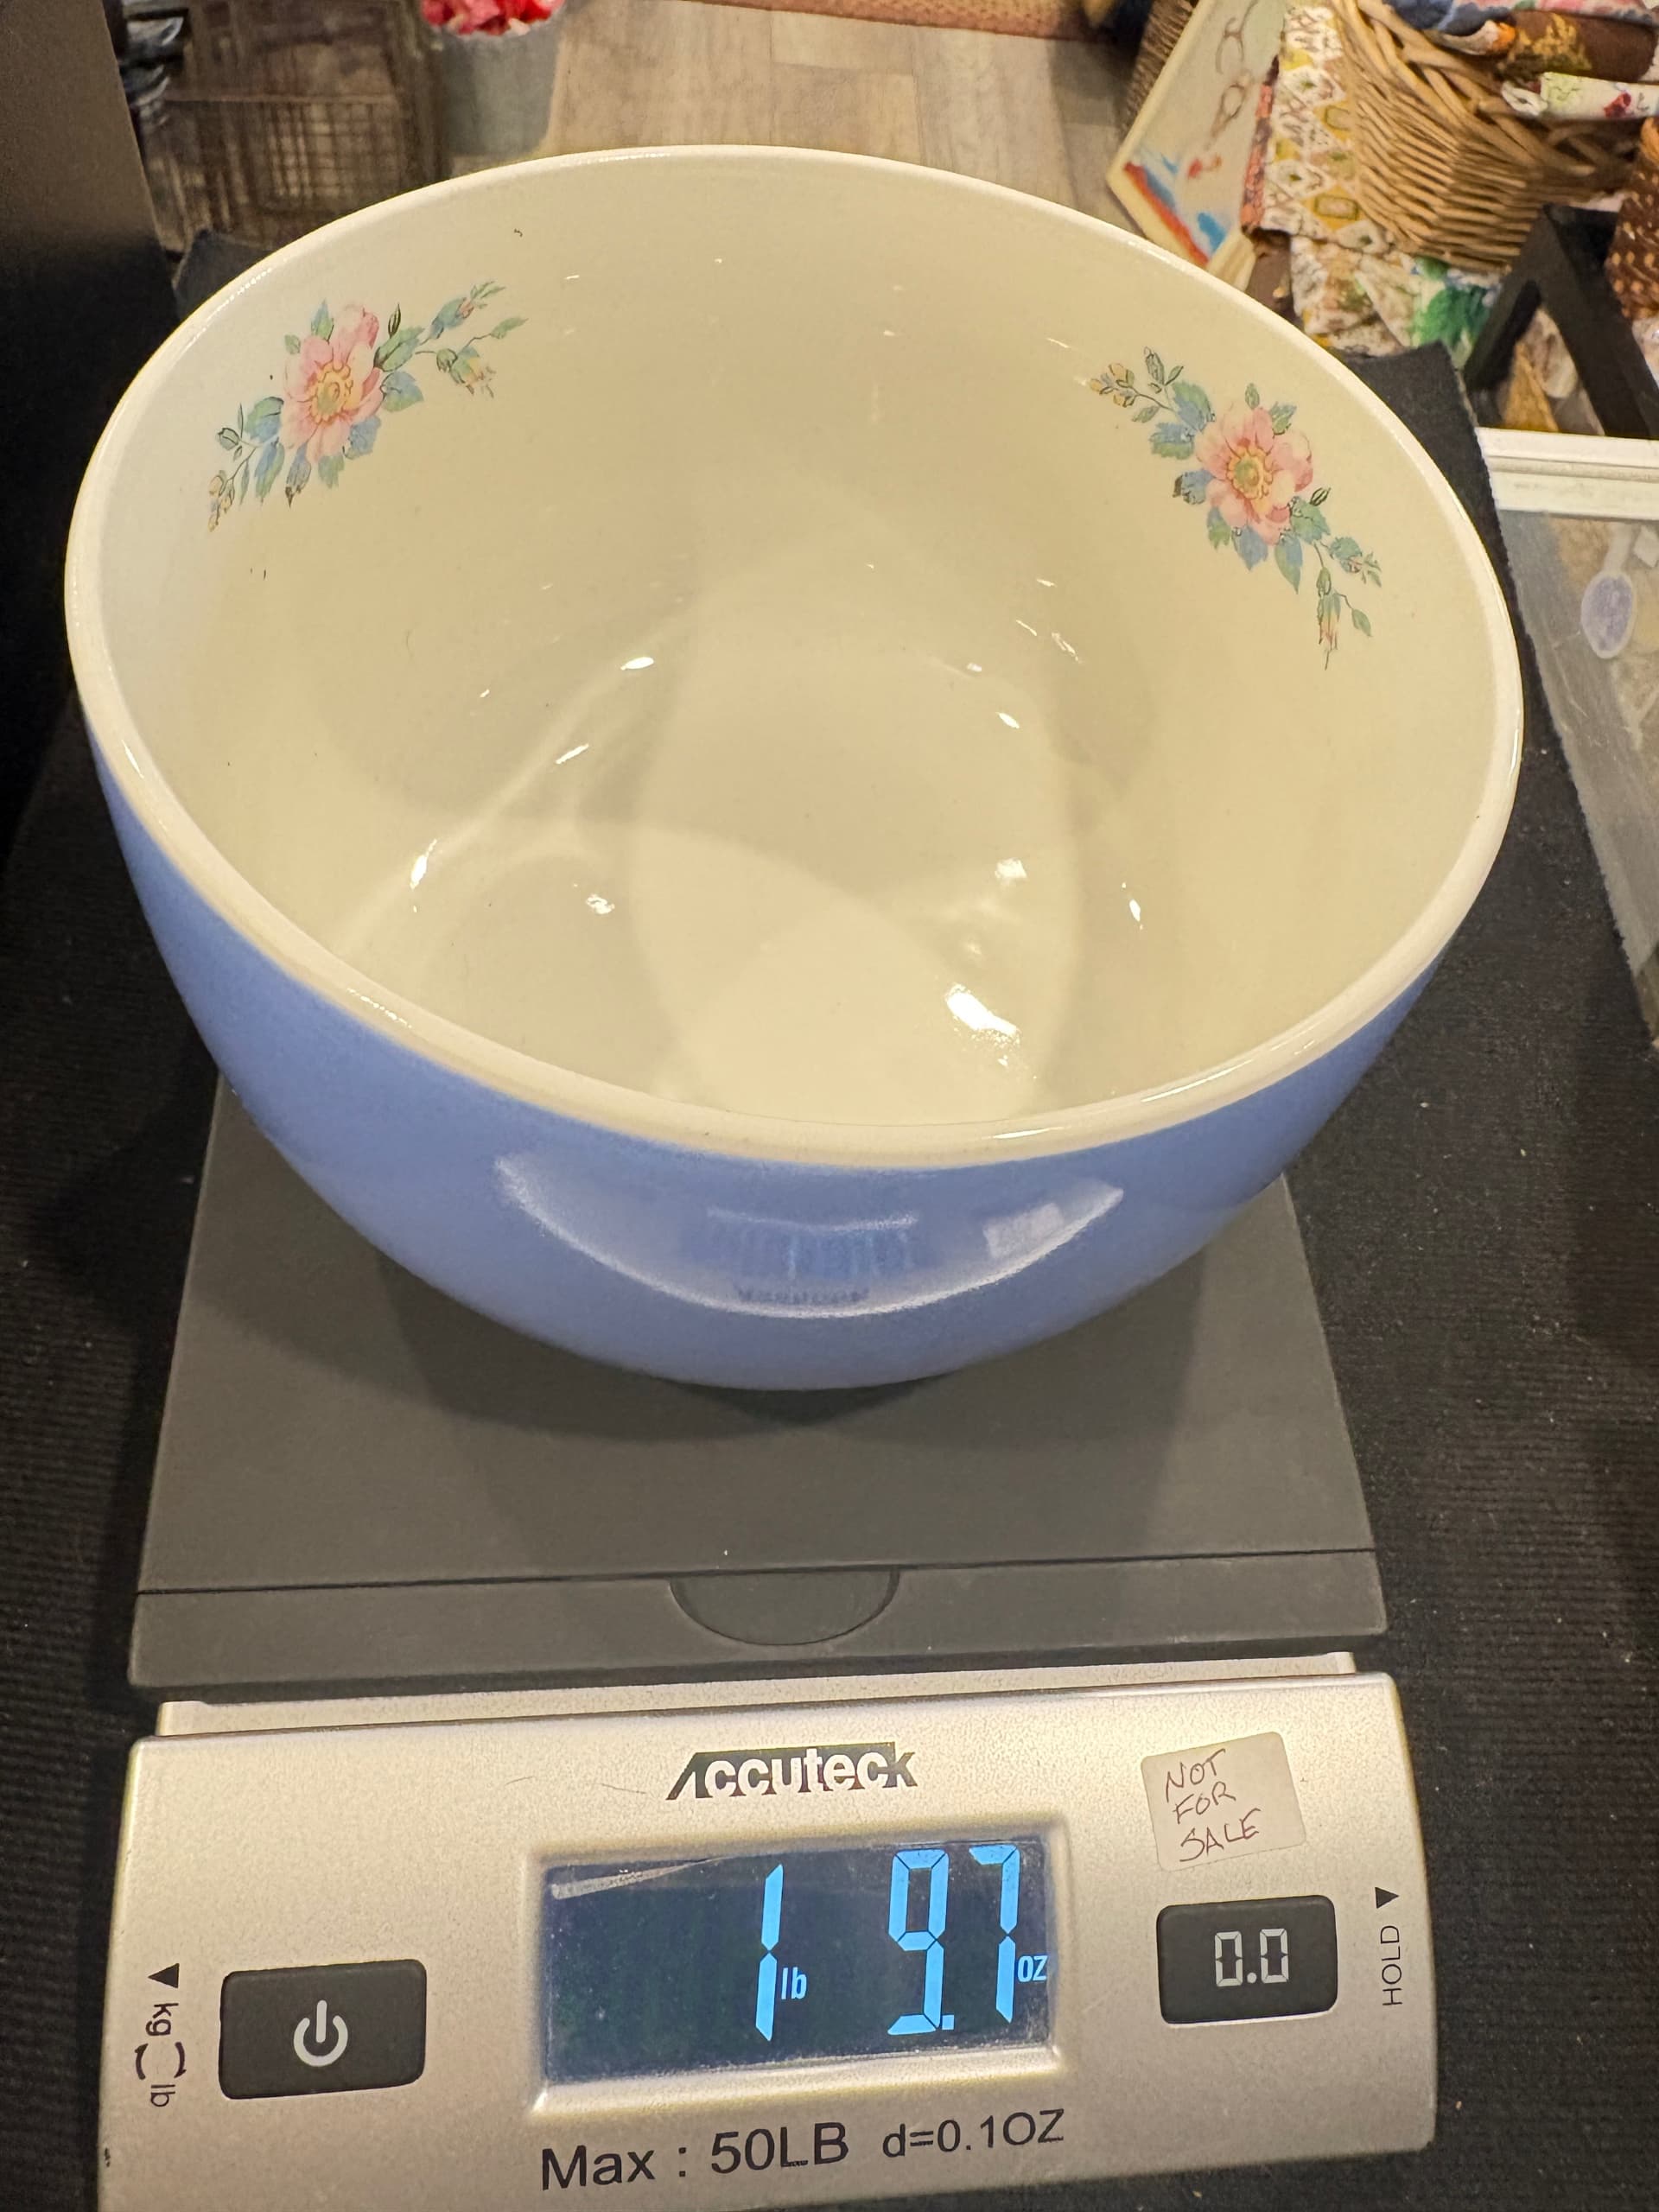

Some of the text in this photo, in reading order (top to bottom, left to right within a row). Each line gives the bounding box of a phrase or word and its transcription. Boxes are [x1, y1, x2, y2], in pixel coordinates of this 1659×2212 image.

[1166, 1748, 1225, 1803] NOT
[1173, 1781, 1236, 1825] FOR
[1179, 1807, 1261, 1862] SALE
[755, 1864, 784, 2042] 1
[781, 1967, 807, 1999] lb
[887, 1844, 1020, 2036] 9.7
[1214, 1928, 1289, 1987] 0.0
[1380, 1924, 1402, 2006] HOLD
[145, 2002, 180, 2037] kg
[150, 2084, 176, 2107] lb
[542, 2145, 655, 2190] Max
[710, 2122, 849, 2175] 50LB
